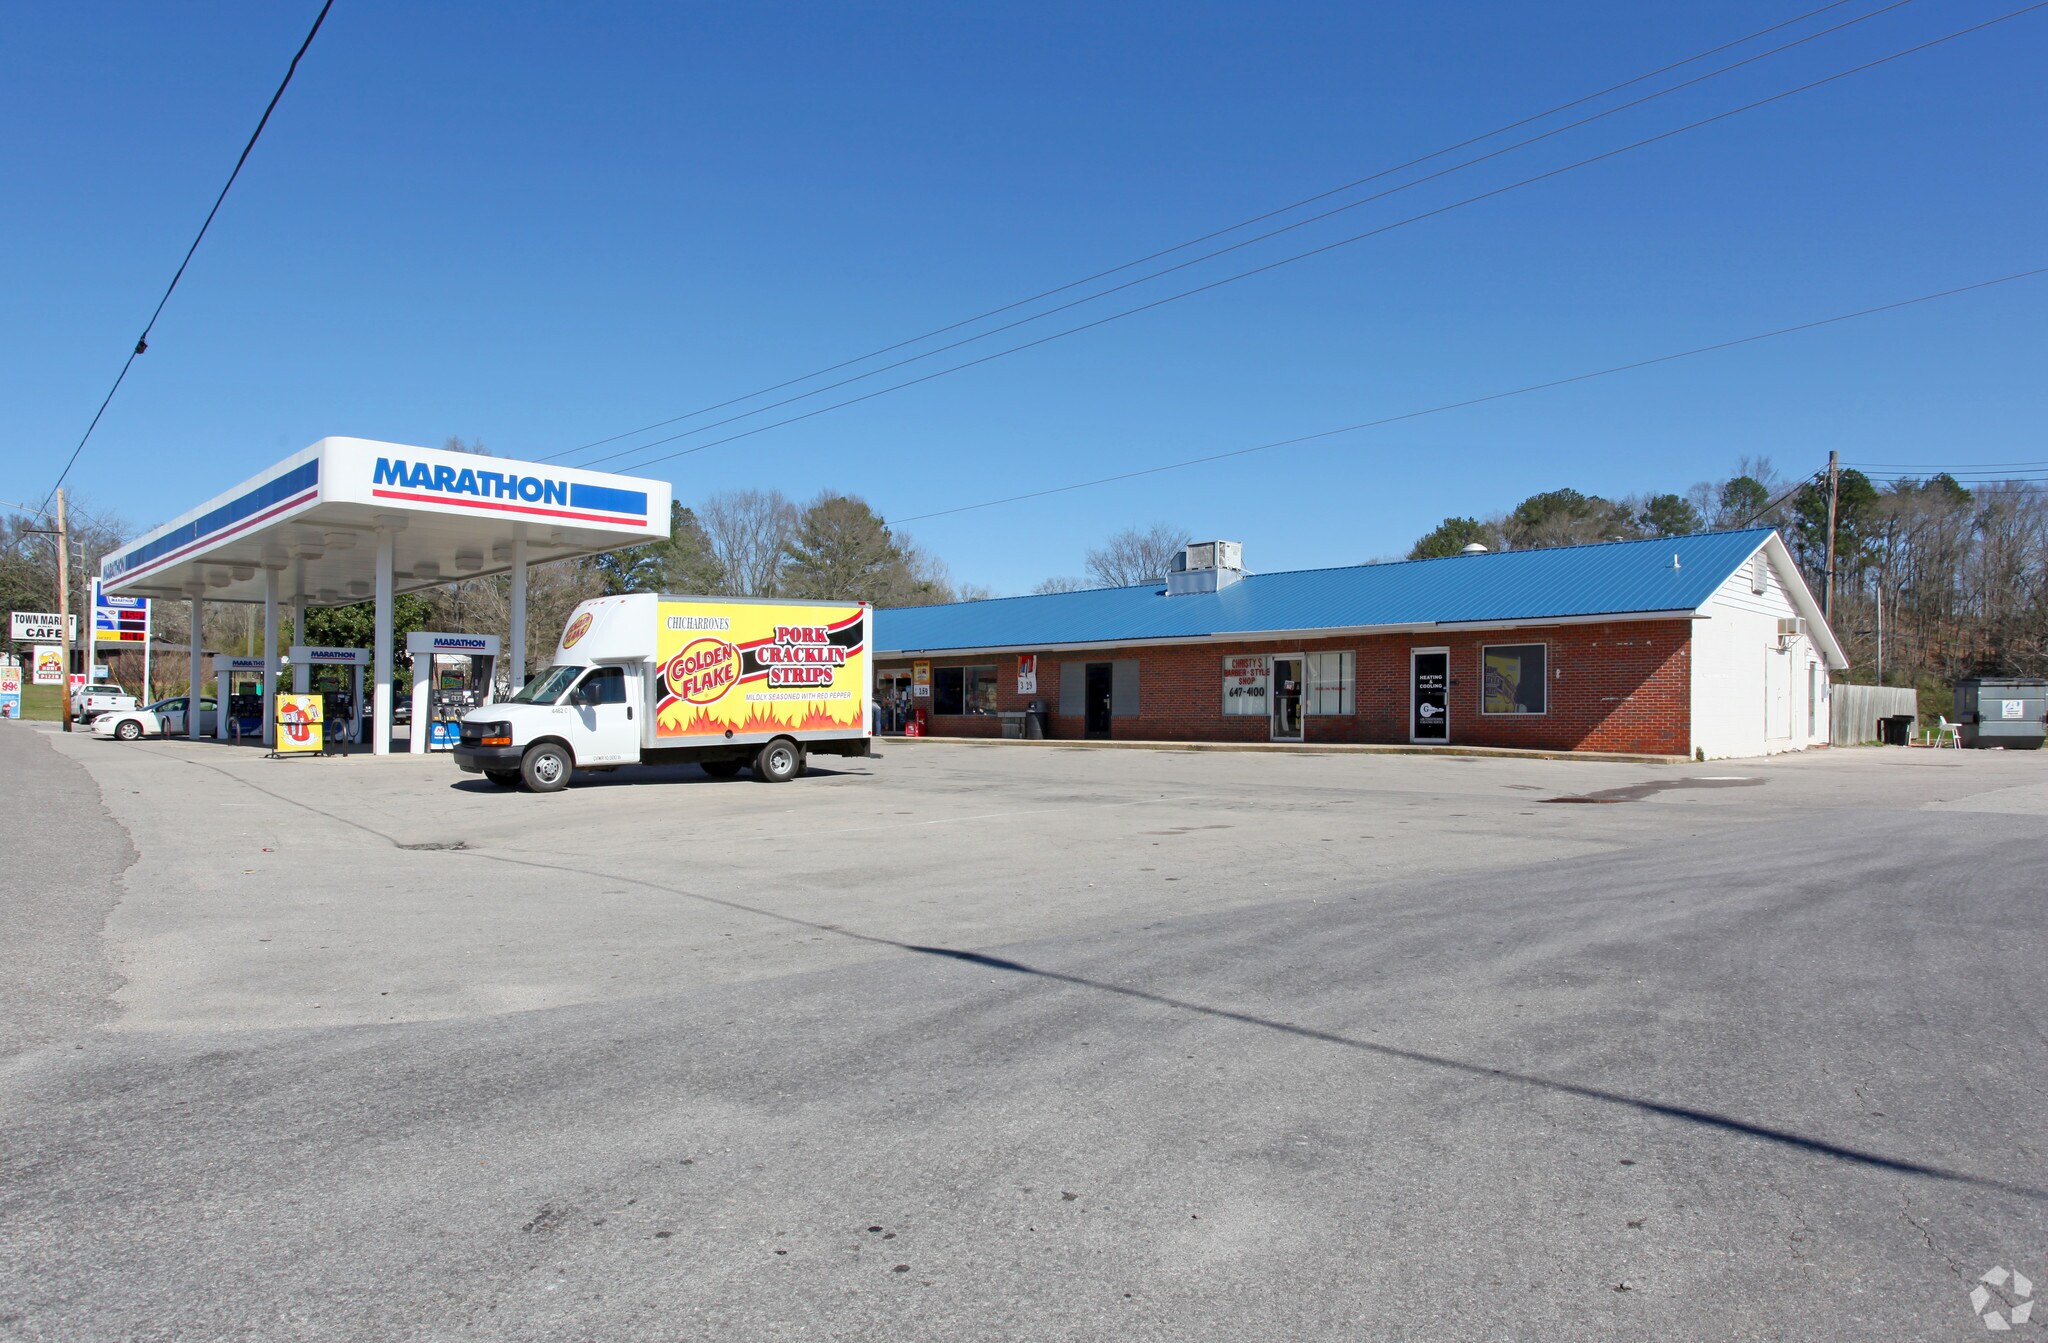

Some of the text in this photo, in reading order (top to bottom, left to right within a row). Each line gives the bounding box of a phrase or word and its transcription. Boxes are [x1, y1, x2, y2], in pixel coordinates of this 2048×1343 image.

[373, 457, 567, 506] MARATHON
[14, 614, 74, 626] TOWN MART
[667, 616, 729, 630] CHICHARRONES
[26, 628, 62, 638] CAFE
[777, 627, 828, 643] PORK
[434, 638, 485, 647] MARATHON
[672, 643, 733, 680] GOLDEN
[757, 647, 845, 664] CRACKLIN
[1232, 658, 1262, 668] CHRISTY'S
[682, 663, 734, 699] FLAKE
[770, 667, 833, 684] STRIPS
[1239, 677, 1255, 685] SHOP
[1229, 687, 1265, 697] 647-4100
